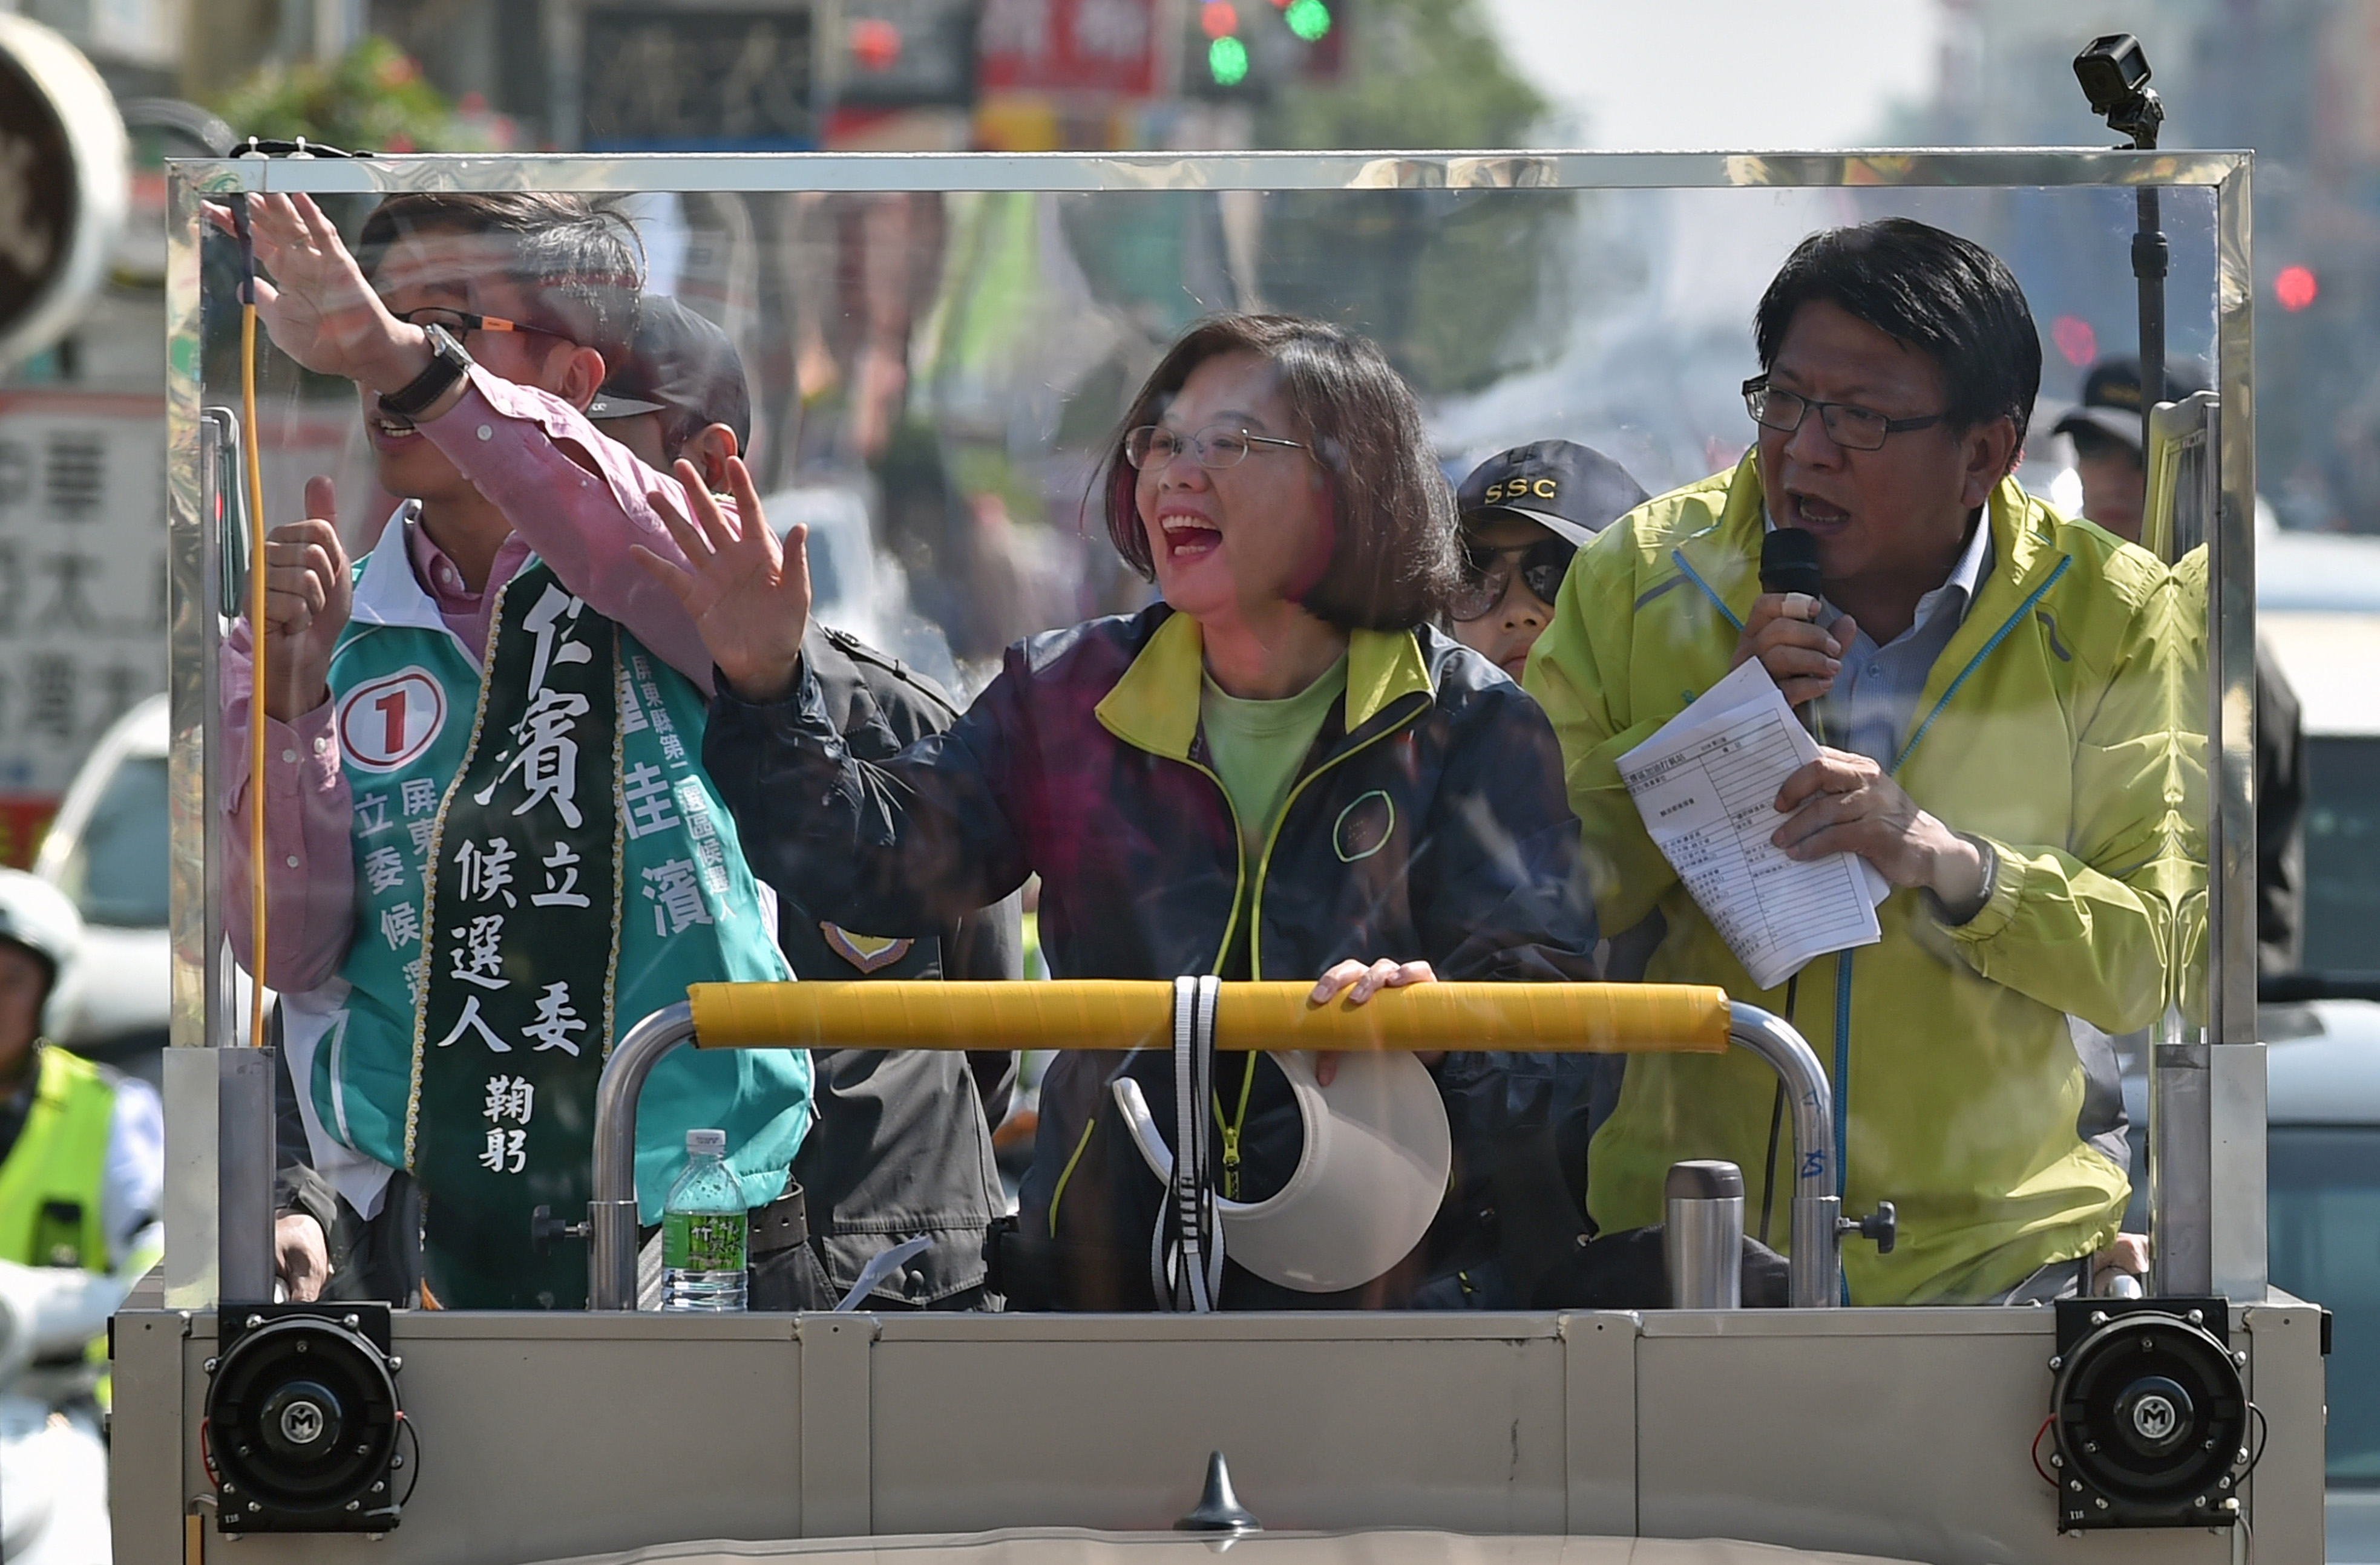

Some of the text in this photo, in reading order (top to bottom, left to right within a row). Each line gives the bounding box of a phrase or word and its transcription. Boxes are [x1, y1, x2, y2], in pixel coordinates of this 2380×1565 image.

[1484, 479, 1556, 505] SSC
[375, 689, 406, 754] 1
[438, 837, 519, 1053] 候選人
[479, 1074, 535, 1174] 鞠躬
